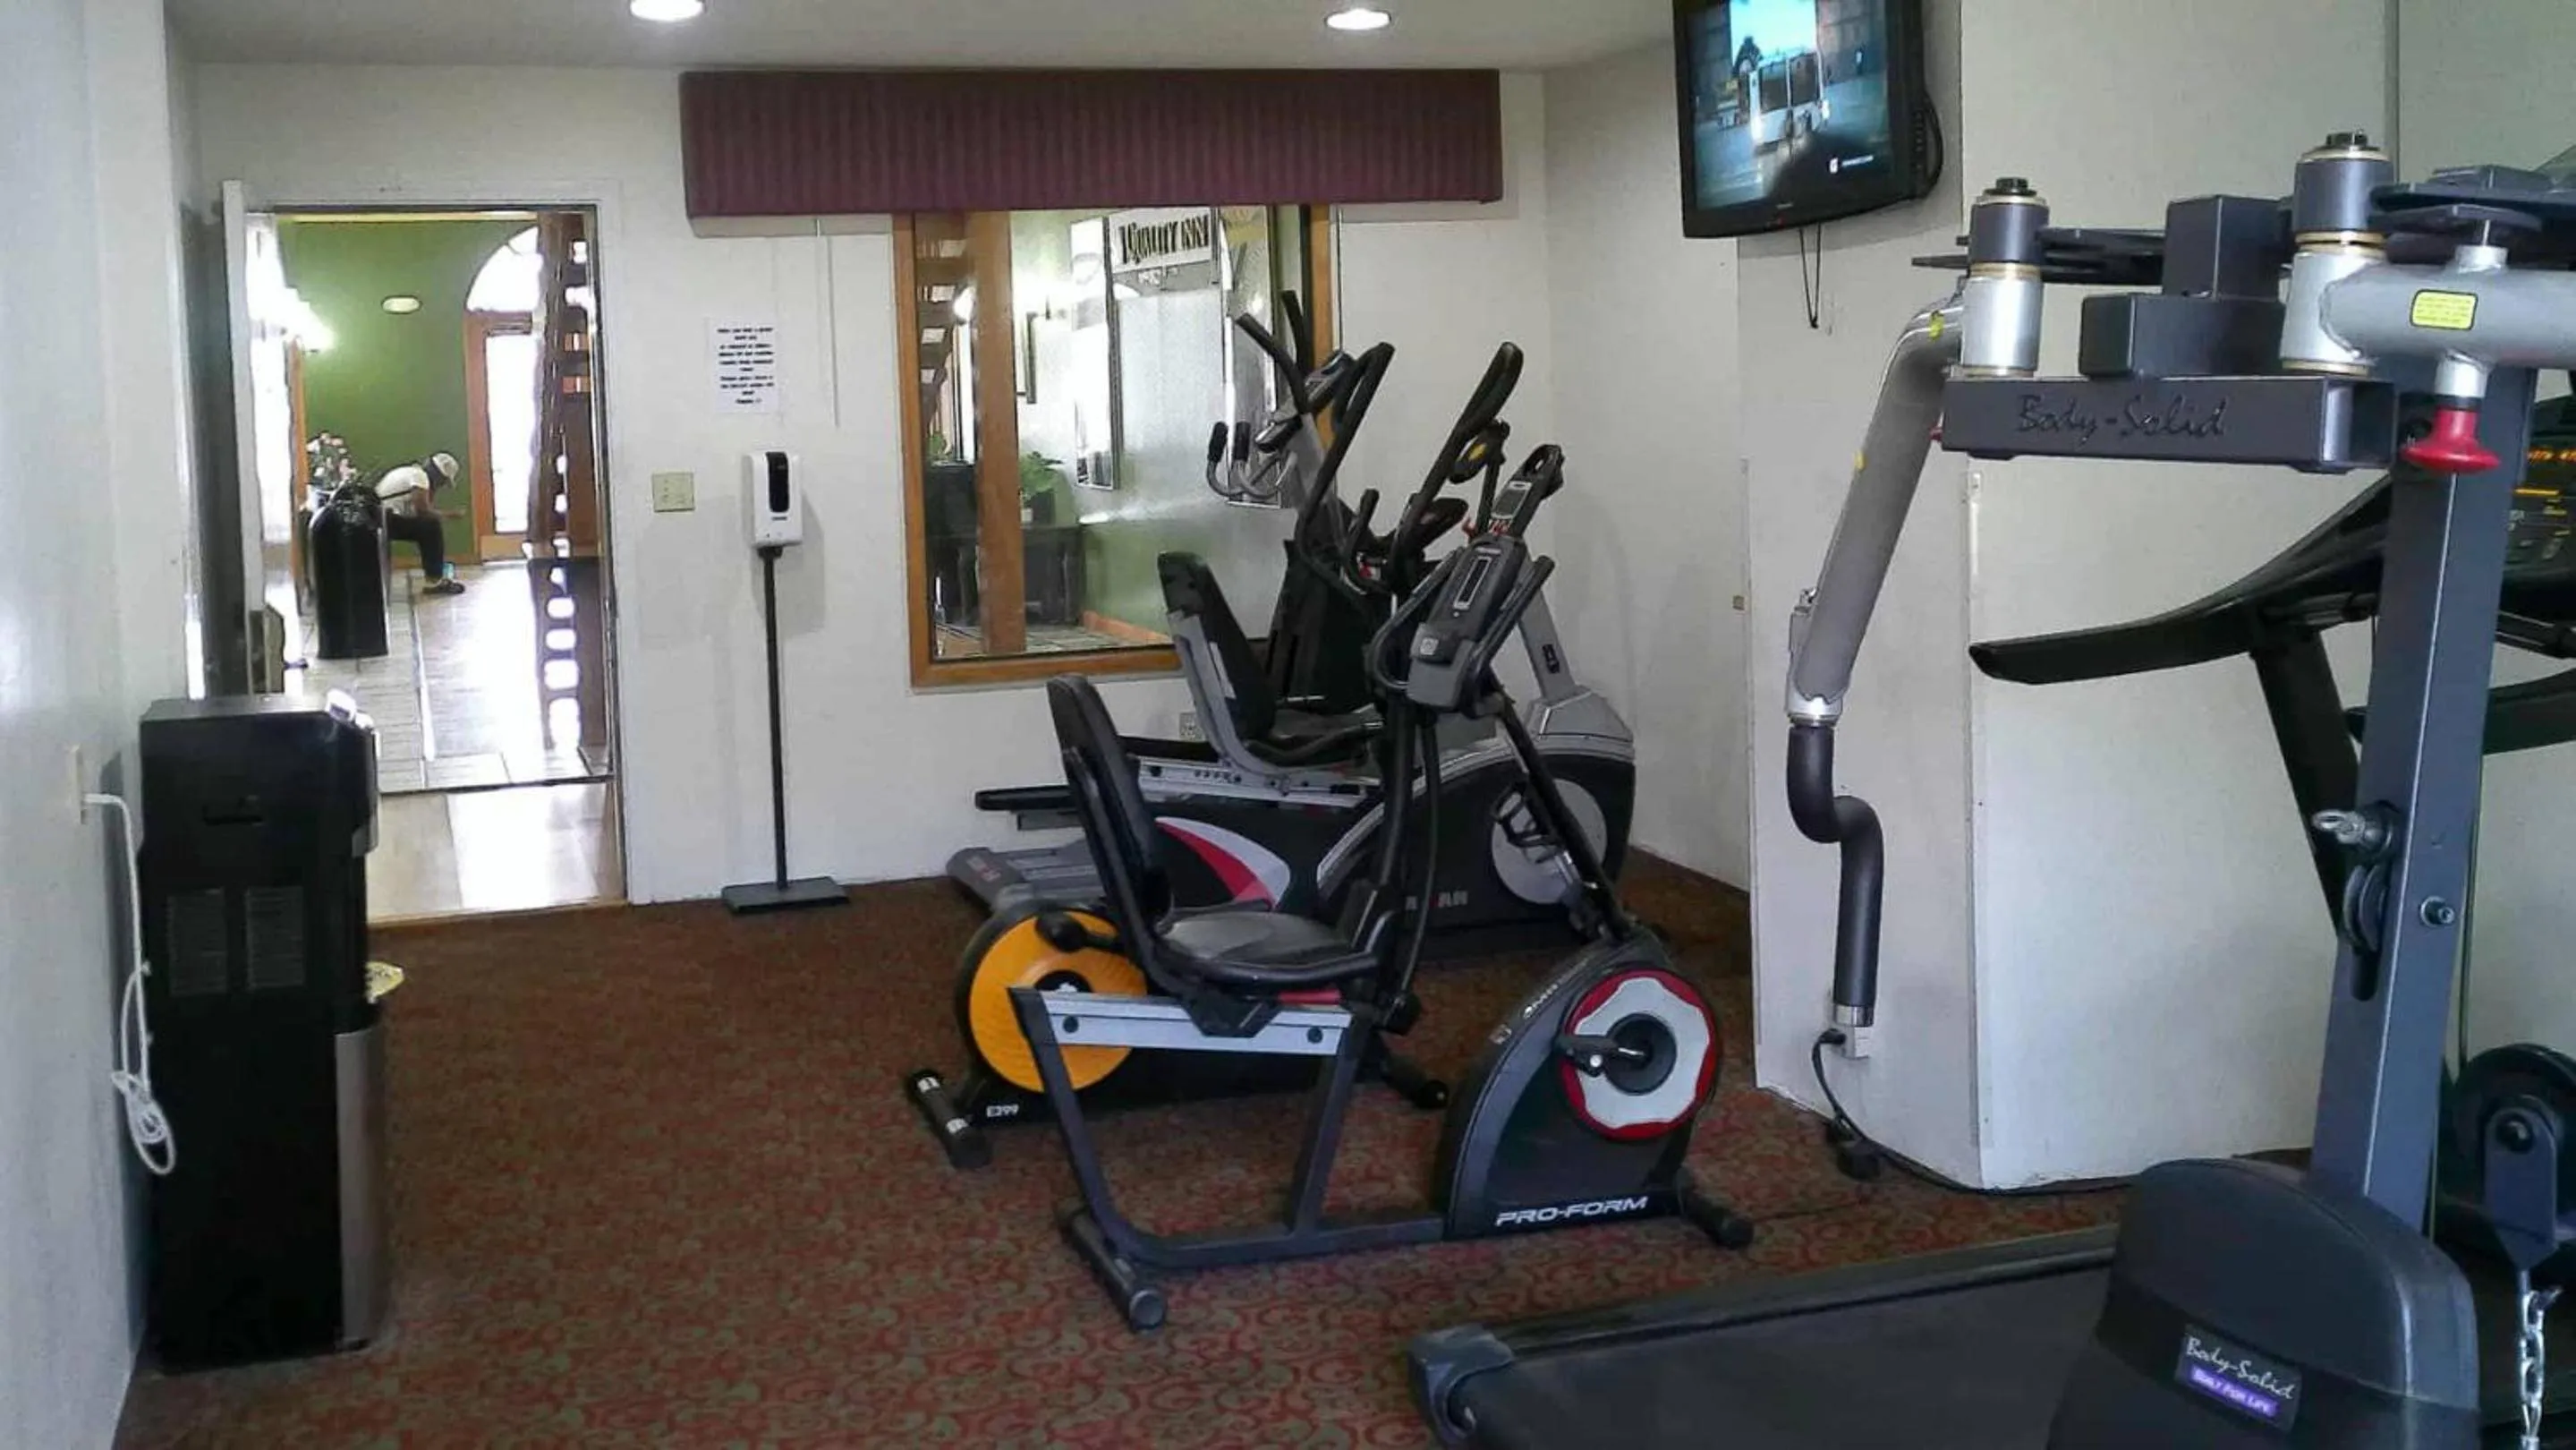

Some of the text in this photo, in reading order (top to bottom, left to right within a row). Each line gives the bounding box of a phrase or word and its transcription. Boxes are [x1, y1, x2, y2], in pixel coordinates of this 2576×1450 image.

[2017, 394, 2229, 447] Body-Solid
[1494, 1195, 1649, 1227] PRO-FORM
[2186, 1335, 2296, 1400] Body-Solid
